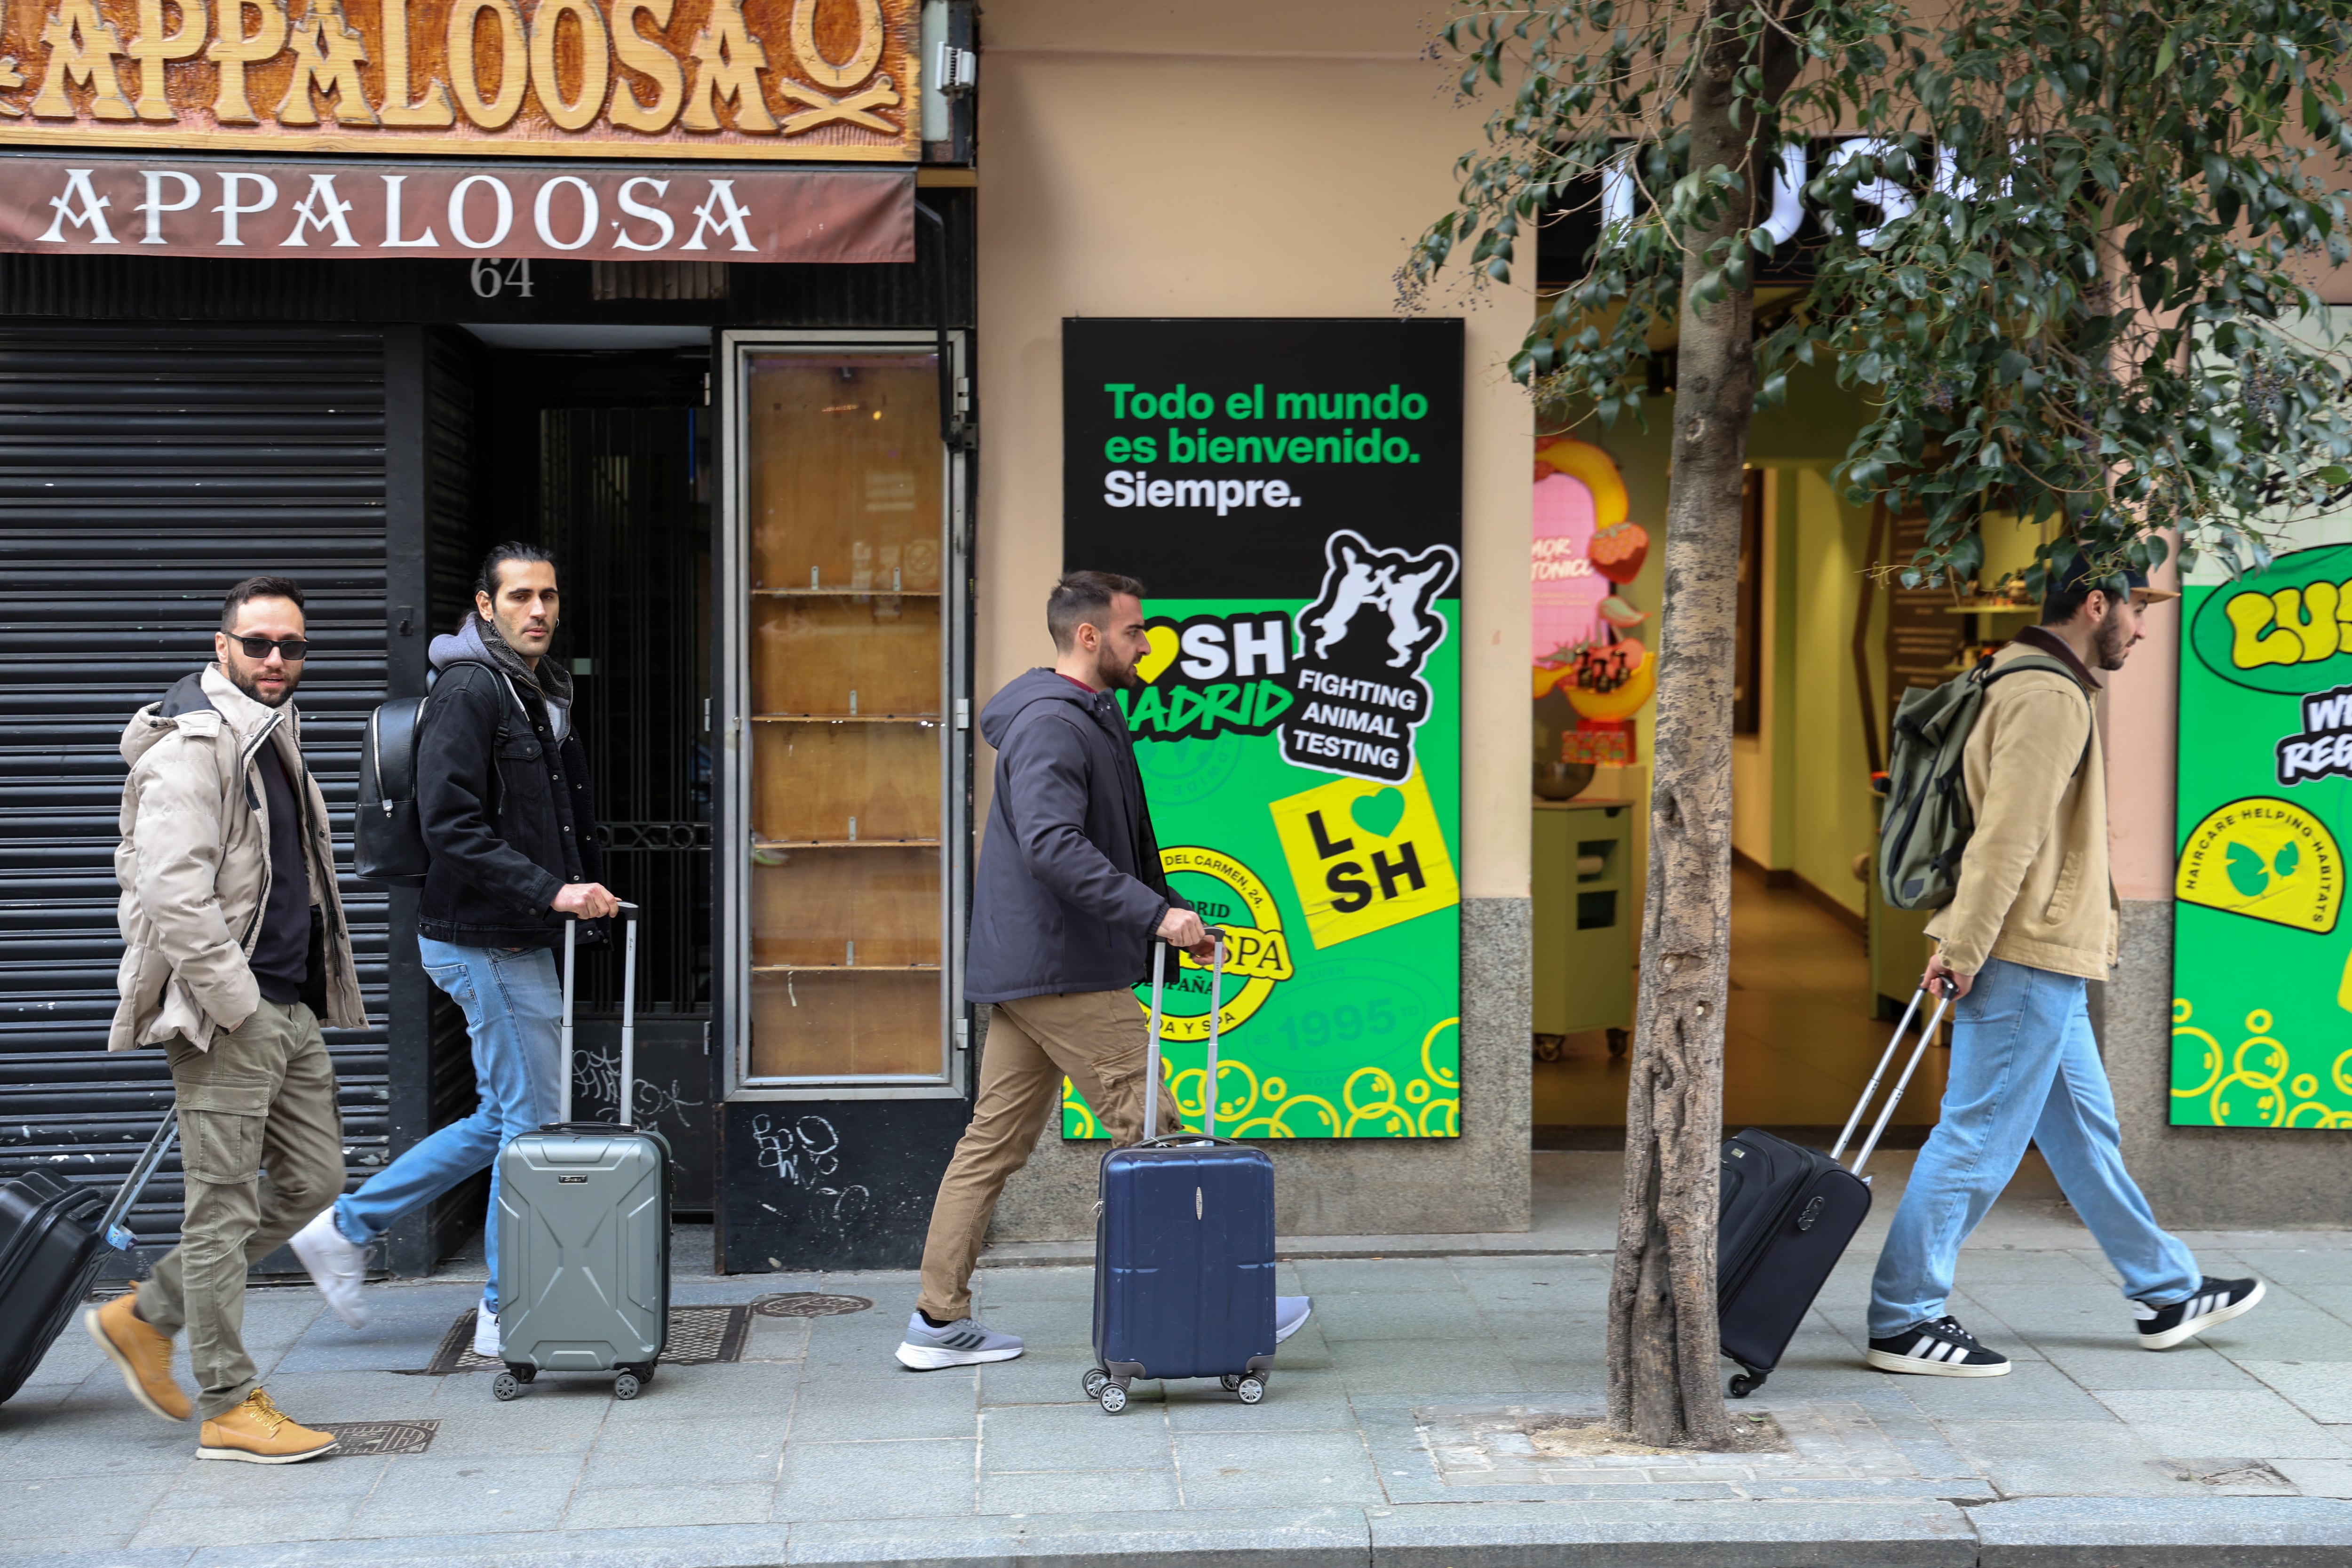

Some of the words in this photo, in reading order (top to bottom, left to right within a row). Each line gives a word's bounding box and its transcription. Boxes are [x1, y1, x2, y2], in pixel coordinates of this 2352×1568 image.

[31, 0, 782, 135] APPALOOSA
[35, 169, 759, 252] APPALOOSA
[471, 258, 534, 298] 64
[1104, 384, 1215, 420] Todo
[1225, 384, 1264, 420] el
[1276, 384, 1429, 420] mundo
[1104, 437, 1157, 463] es
[1168, 428, 1420, 463] bienvenido.
[1104, 470, 1302, 516] Siempre.
[1298, 669, 1418, 711] FIGHTING
[1301, 702, 1400, 739] ANIMAL
[1293, 730, 1400, 769] TESTING
[1165, 854, 1190, 866] DEL
[1194, 855, 1249, 890] CARMEN,
[1325, 841, 1427, 913] SH
[2185, 815, 2235, 890] HAIRCARE
[2241, 808, 2312, 837] HELPING
[2312, 841, 2332, 923] HABITATS
[1310, 965, 1346, 980] LUSH
[1277, 997, 1397, 1052] 1995
